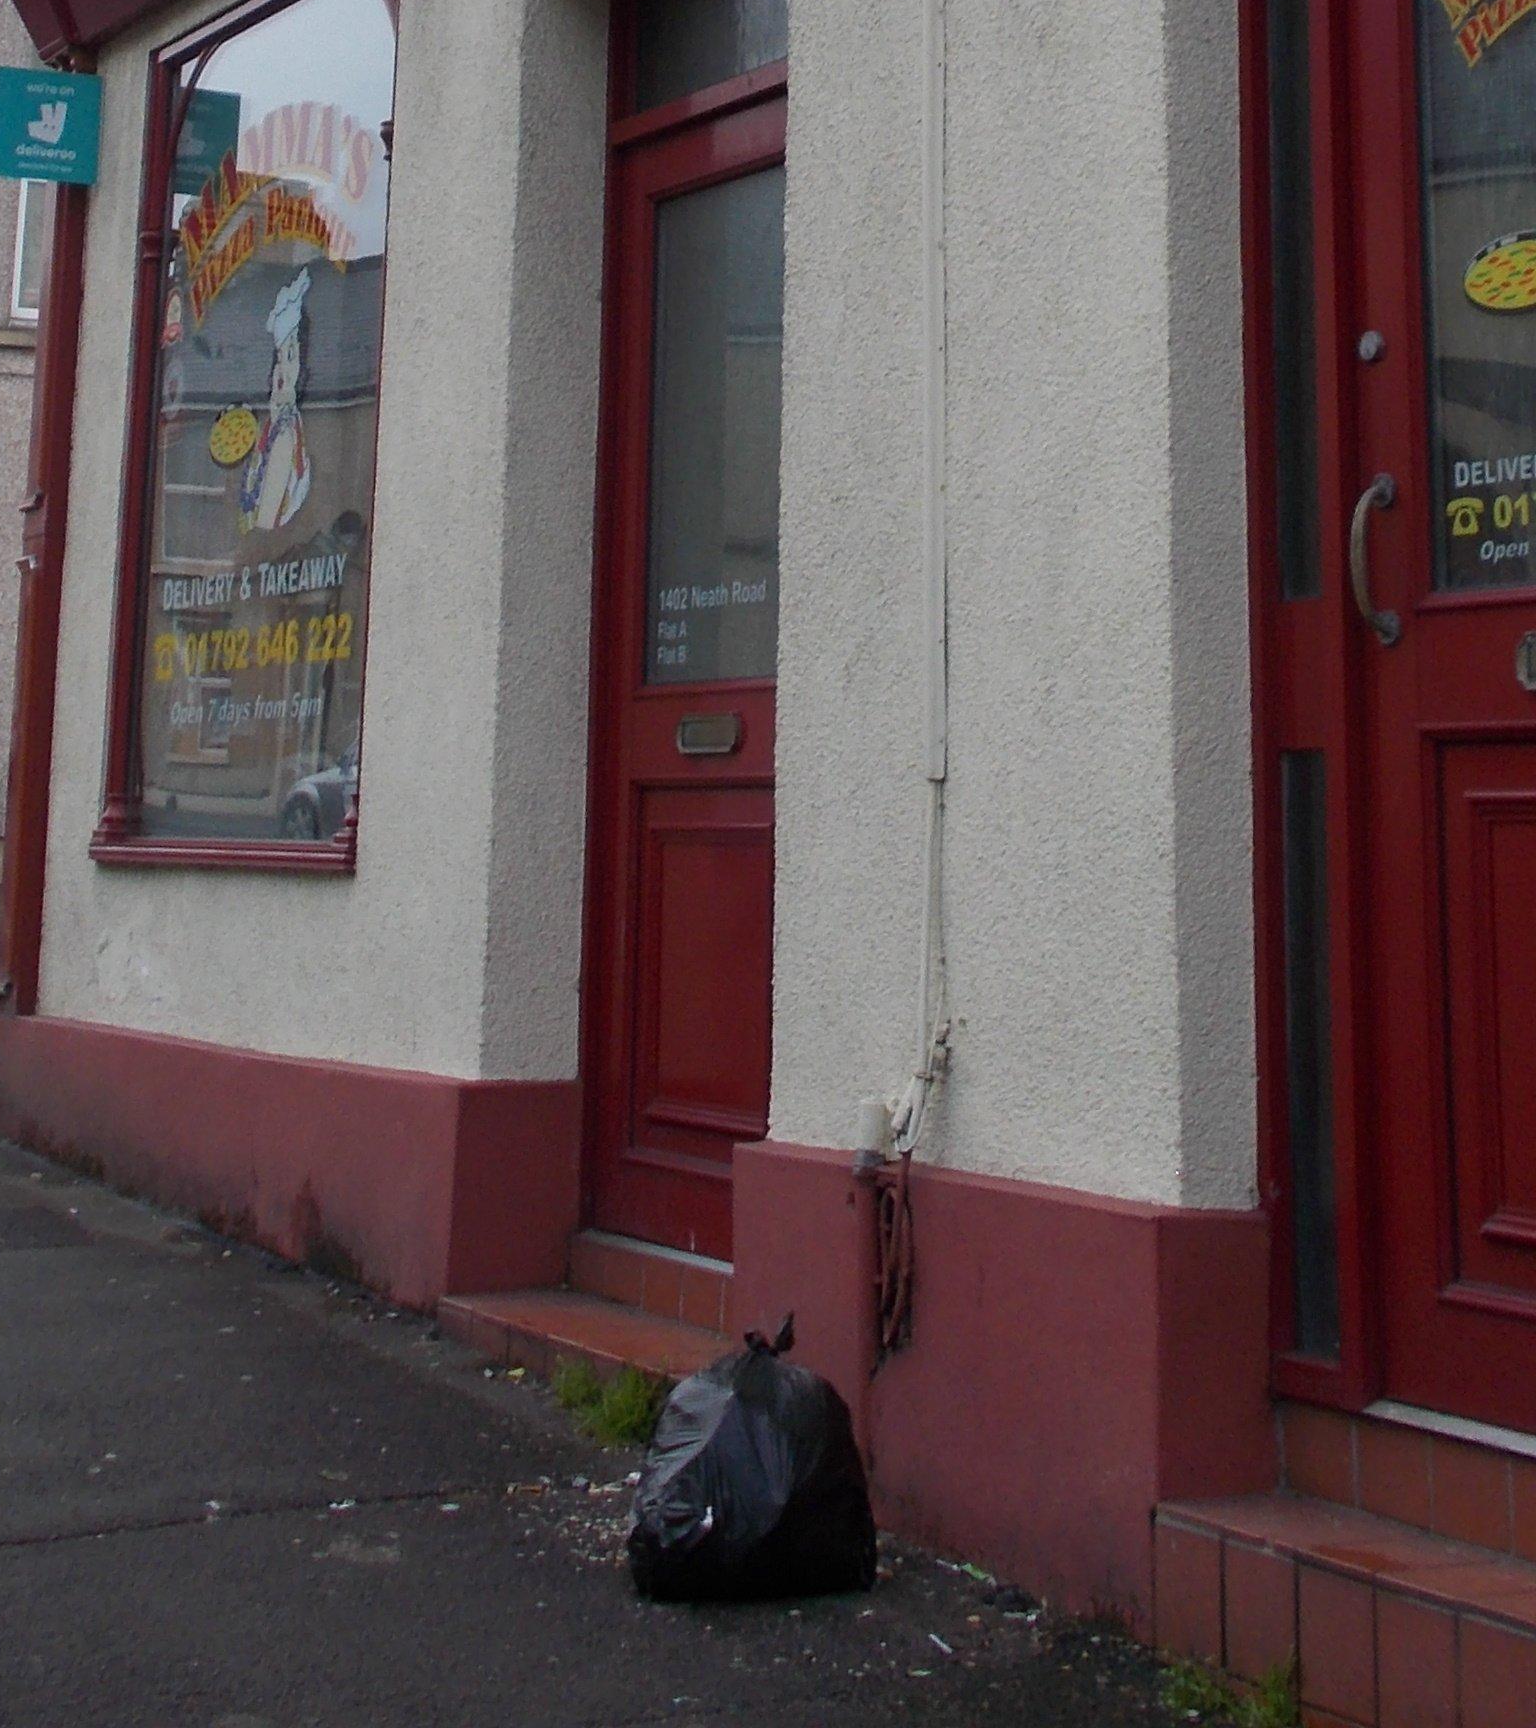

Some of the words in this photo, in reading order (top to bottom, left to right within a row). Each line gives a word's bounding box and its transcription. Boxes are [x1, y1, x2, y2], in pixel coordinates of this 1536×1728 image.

[15, 143, 77, 161] deliveroo
[1479, 539, 1530, 564] Open
[164, 573, 235, 611] DELIVERY
[240, 567, 252, 601] &
[258, 553, 348, 597] TAKEAWAY
[658, 587, 689, 612] 1402
[691, 582, 729, 609] Neath
[731, 577, 766, 604] Road
[184, 626, 251, 675] 01792
[256, 618, 300, 667] 646
[306, 612, 353, 663] 222
[219, 694, 250, 726] days
